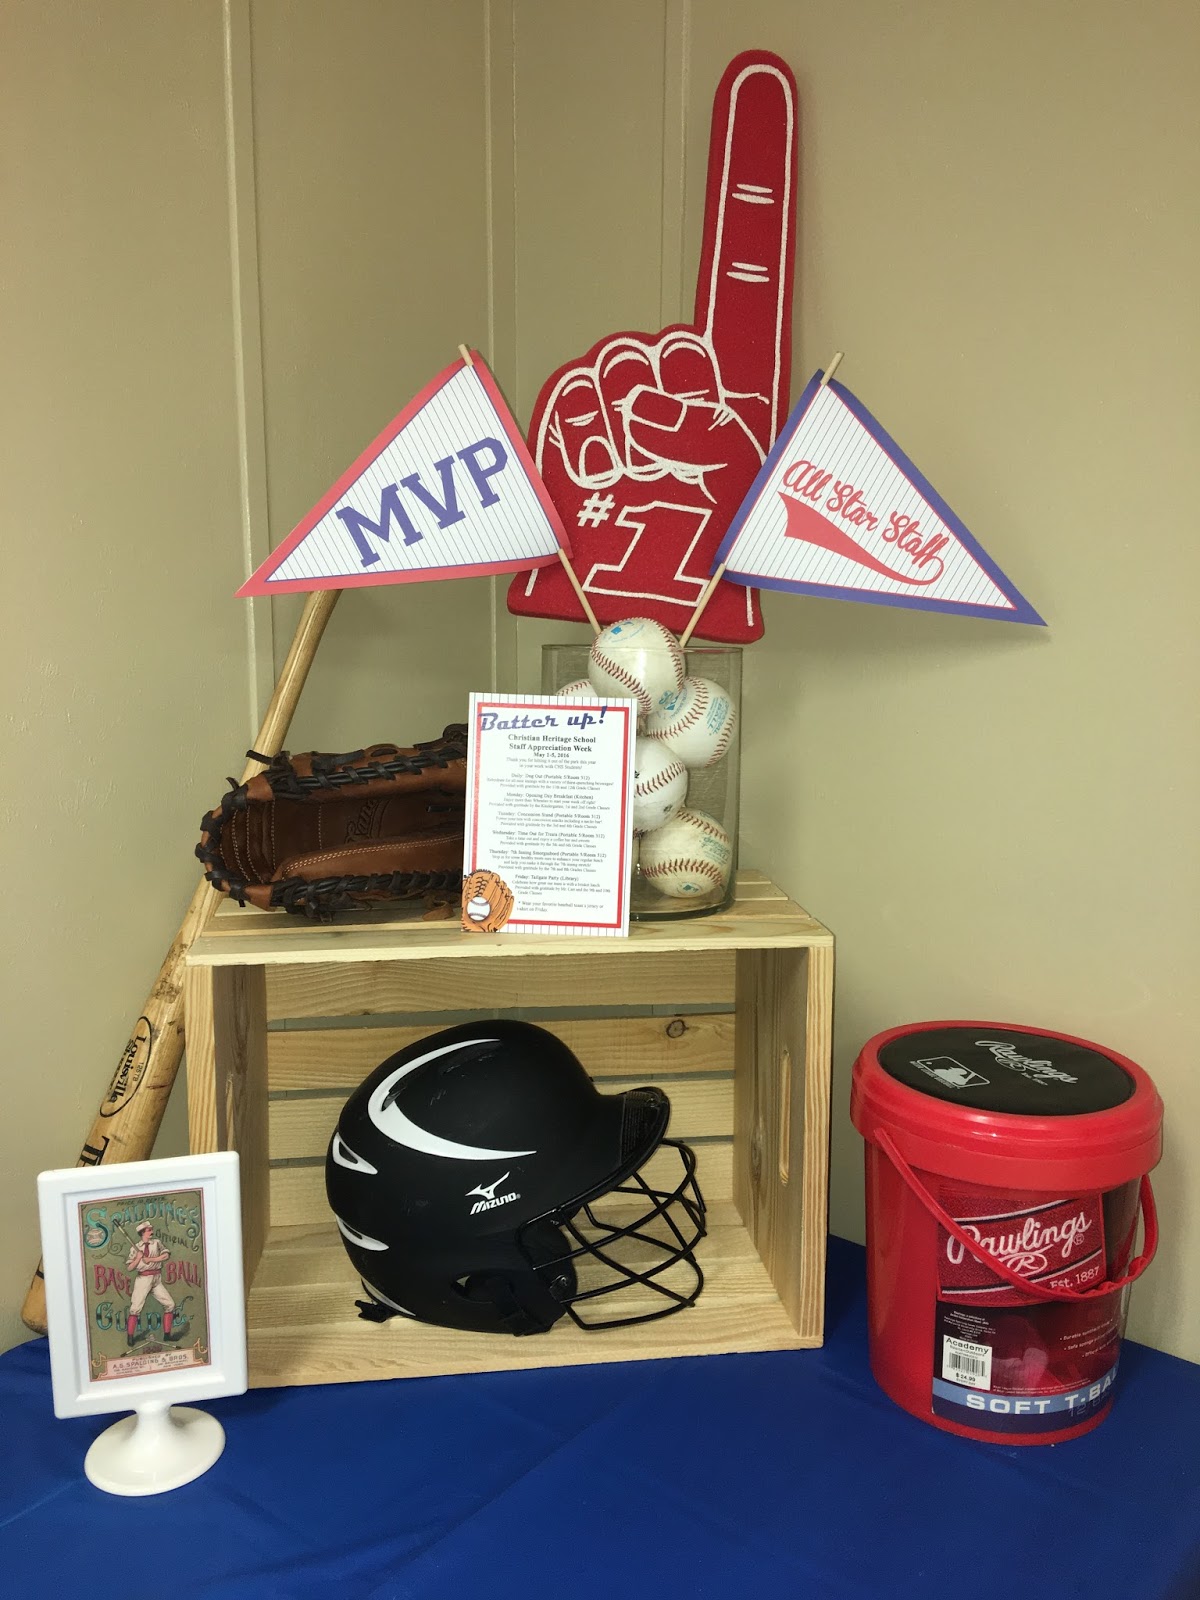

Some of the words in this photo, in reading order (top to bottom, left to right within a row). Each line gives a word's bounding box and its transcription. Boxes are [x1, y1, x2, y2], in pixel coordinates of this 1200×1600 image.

[335, 437, 508, 568] MVP
[782, 460, 833, 501] All
[826, 480, 878, 531] Star
[882, 511, 950, 569] Staff
[477, 712, 558, 731] Batter
[567, 706, 608, 729] up!
[527, 744, 572, 753] Appreciation
[542, 735, 572, 744] Heritage
[109, 1035, 147, 1104] Louisville
[975, 1040, 1079, 1084] Rawlings
[470, 1192, 517, 1215] MIZUNO
[947, 1211, 1092, 1265] Rawlings
[1076, 1265, 1100, 1284] 1887
[946, 1337, 989, 1354] Academy
[966, 1394, 1050, 1414] SOFT
